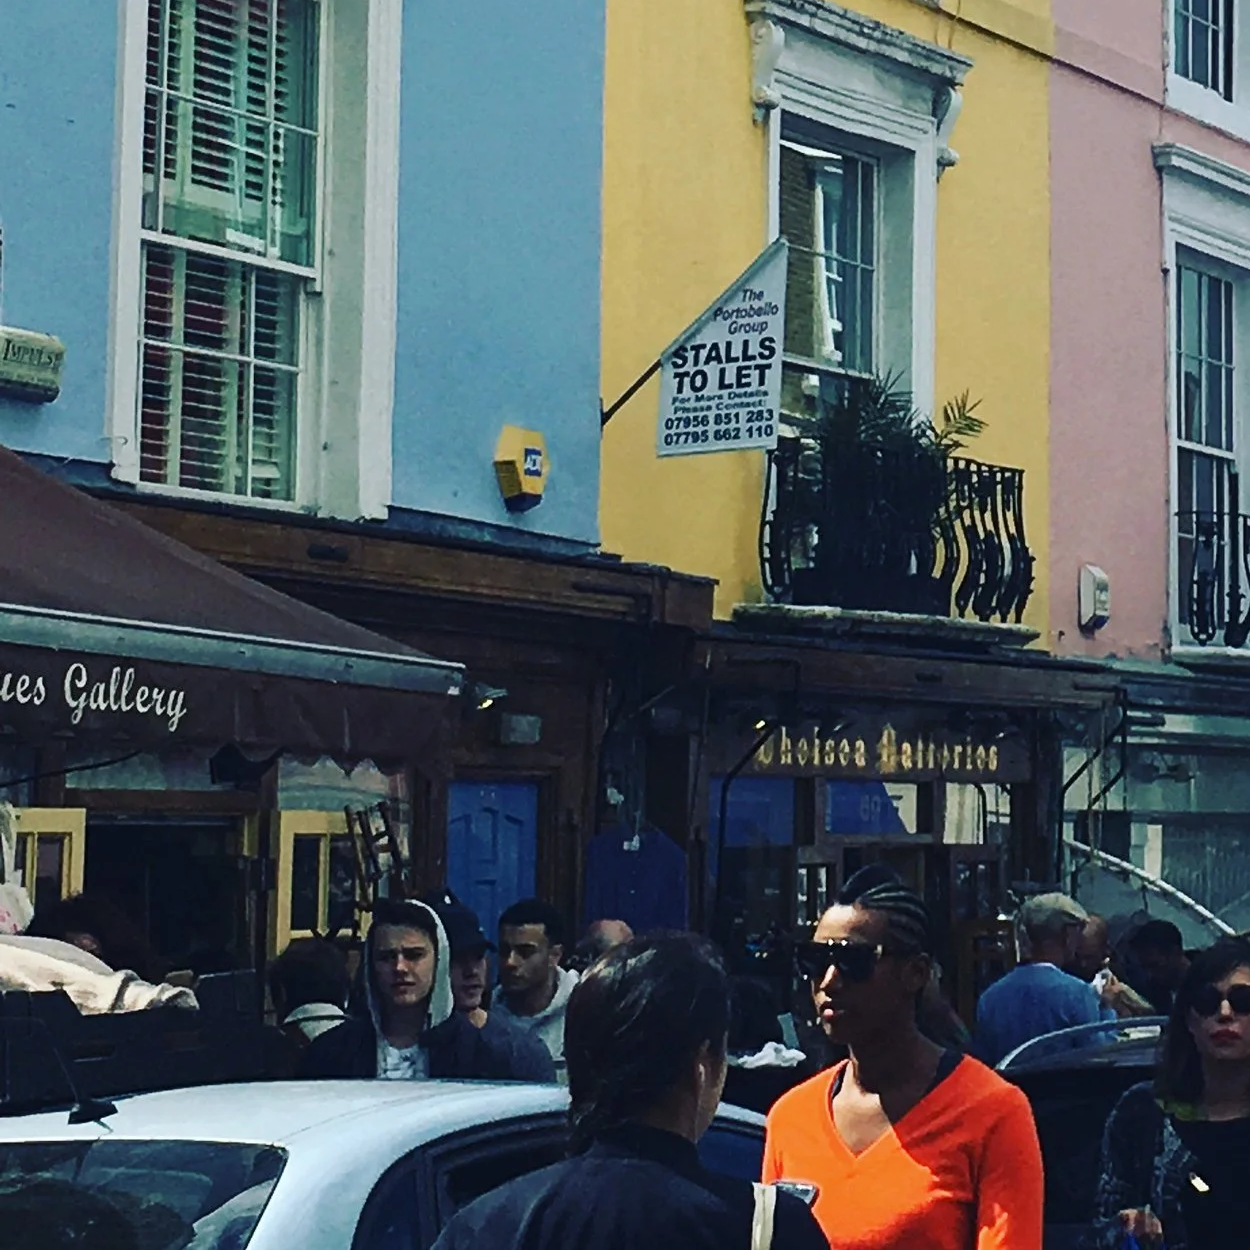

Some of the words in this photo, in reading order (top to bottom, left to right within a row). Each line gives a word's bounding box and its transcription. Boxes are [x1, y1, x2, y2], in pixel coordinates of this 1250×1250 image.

[742, 288, 765, 303] The
[713, 301, 779, 321] Portobello
[728, 320, 769, 335] Group
[670, 336, 777, 369] STALLS
[673, 368, 709, 395] TO
[718, 363, 773, 391] LET
[664, 414, 710, 431] 07956
[713, 411, 741, 427] 851
[745, 408, 774, 424] 283
[663, 429, 710, 446] 07795
[745, 423, 774, 439] 110
[64, 662, 187, 732] Gallery
